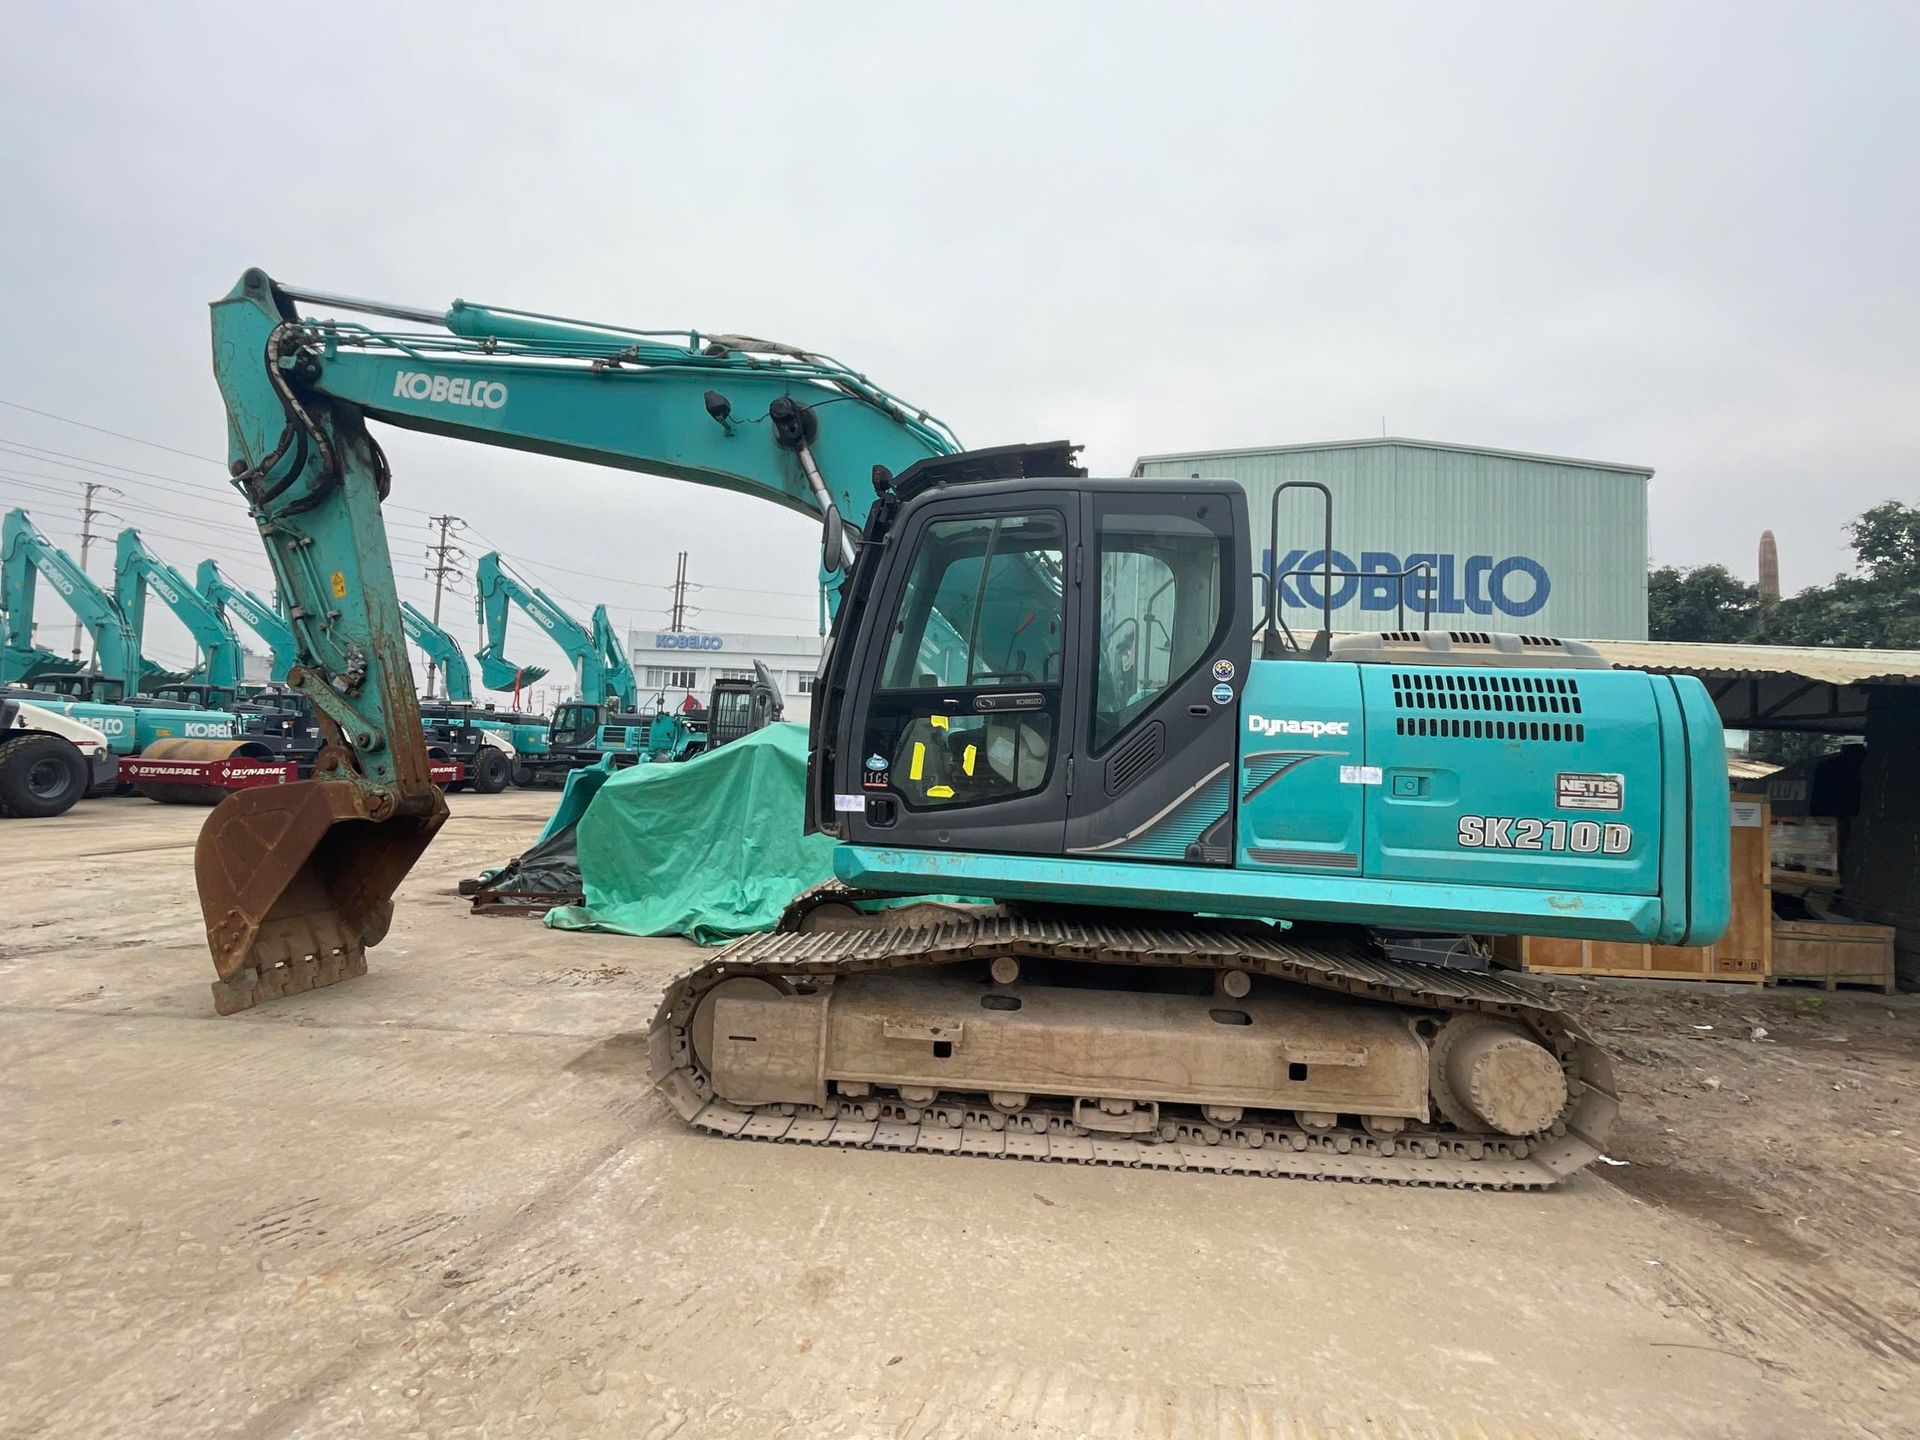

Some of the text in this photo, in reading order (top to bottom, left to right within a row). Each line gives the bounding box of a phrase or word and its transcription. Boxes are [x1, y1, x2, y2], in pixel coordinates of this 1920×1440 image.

[393, 370, 508, 409] KOBELCO
[39, 557, 73, 595] KOBELCO
[146, 570, 178, 603] KOBELCO
[1262, 549, 1551, 617] KOBELCO
[227, 596, 258, 625] KOBELCO
[656, 634, 722, 650] KOBELCO
[71, 716, 123, 734] BELCO
[1248, 714, 1350, 738] Dynaspec
[139, 766, 201, 776] DYNAPAC
[231, 767, 287, 776] DYNAPAC
[864, 772, 889, 784] ITCS
[1560, 779, 1618, 794] NETIS
[1458, 815, 1632, 854] SK210D
